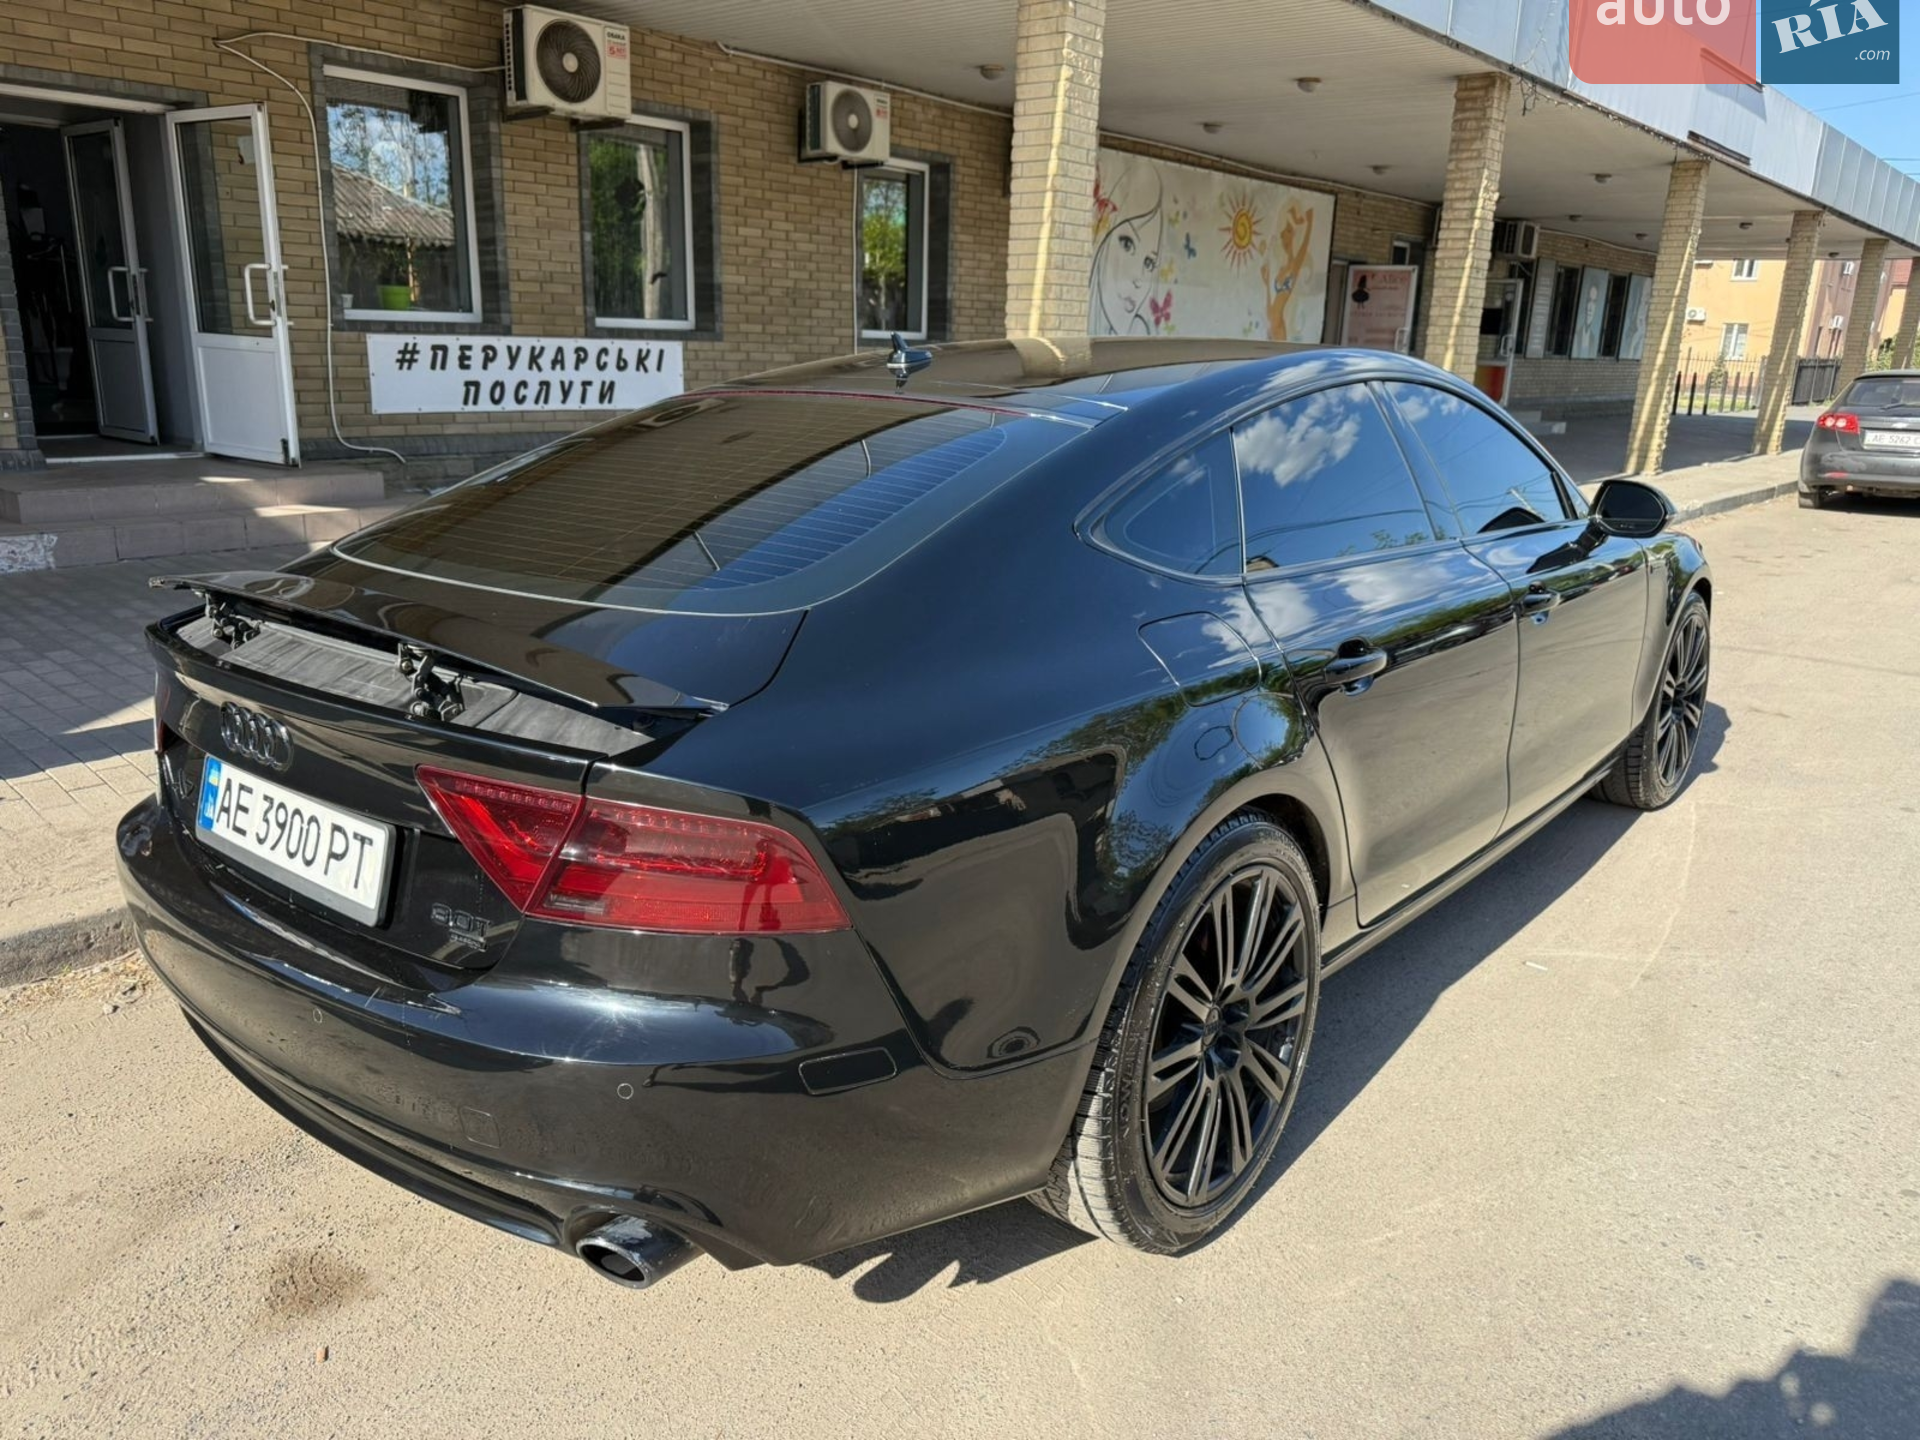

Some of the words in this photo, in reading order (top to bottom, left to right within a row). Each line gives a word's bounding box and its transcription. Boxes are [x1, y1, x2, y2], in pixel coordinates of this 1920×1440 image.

[395, 342, 664, 373] #ПЕРУКАРСЬКІ
[462, 379, 616, 406] ПОСЛУГИ
[216, 777, 254, 838] AE
[255, 794, 321, 867] 3900
[323, 823, 373, 889] PT
